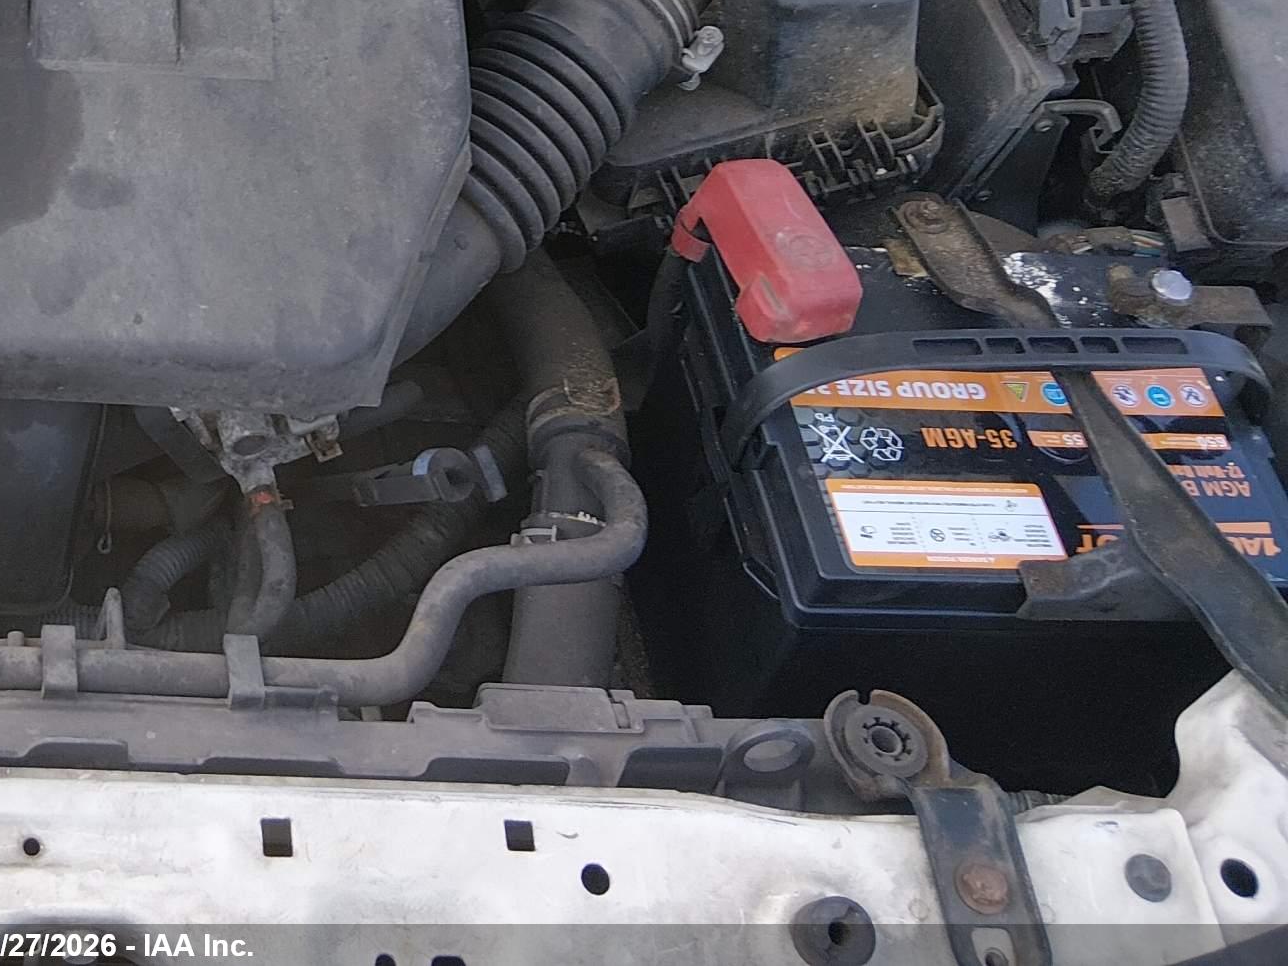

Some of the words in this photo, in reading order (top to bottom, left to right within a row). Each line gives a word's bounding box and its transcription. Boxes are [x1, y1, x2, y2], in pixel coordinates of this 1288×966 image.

[835, 379, 893, 397] SIZE
[898, 380, 986, 400] GROUP
[920, 427, 1018, 449] 35-AGM
[1062, 432, 1085, 447] 55
[1180, 480, 1201, 497] B
[1202, 481, 1252, 498] AGM
